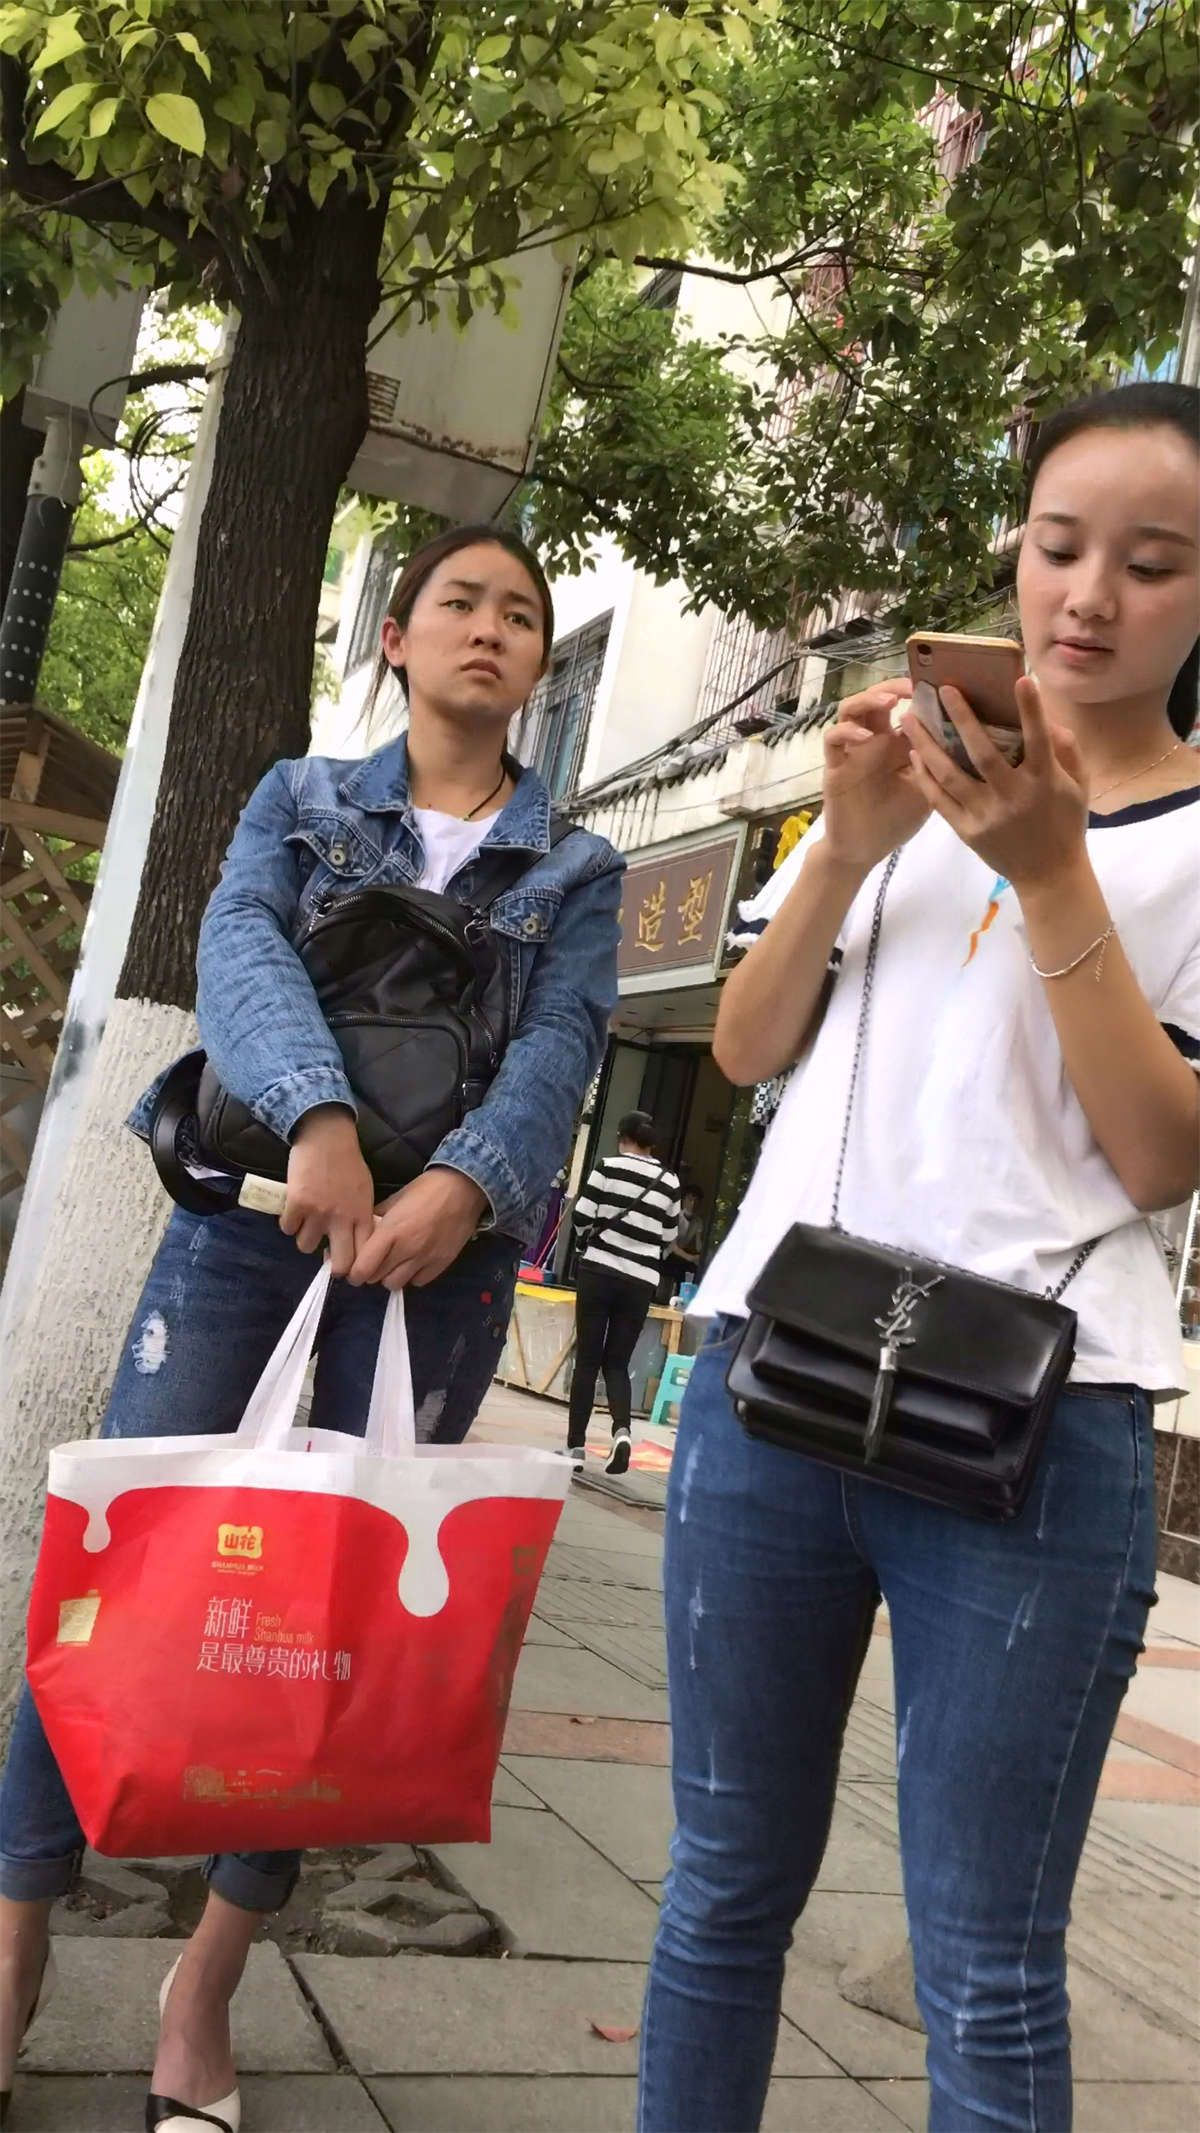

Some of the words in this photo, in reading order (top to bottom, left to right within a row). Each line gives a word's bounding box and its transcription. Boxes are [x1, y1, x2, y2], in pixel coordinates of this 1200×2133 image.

[618, 868, 712, 952] 造型
[224, 1529, 257, 1550] 山花
[204, 1597, 252, 1639] 新鲜
[256, 1611, 281, 1627] Fresh
[296, 1631, 314, 1645] milk
[197, 1641, 351, 1680] 是最尊贵的礼物
